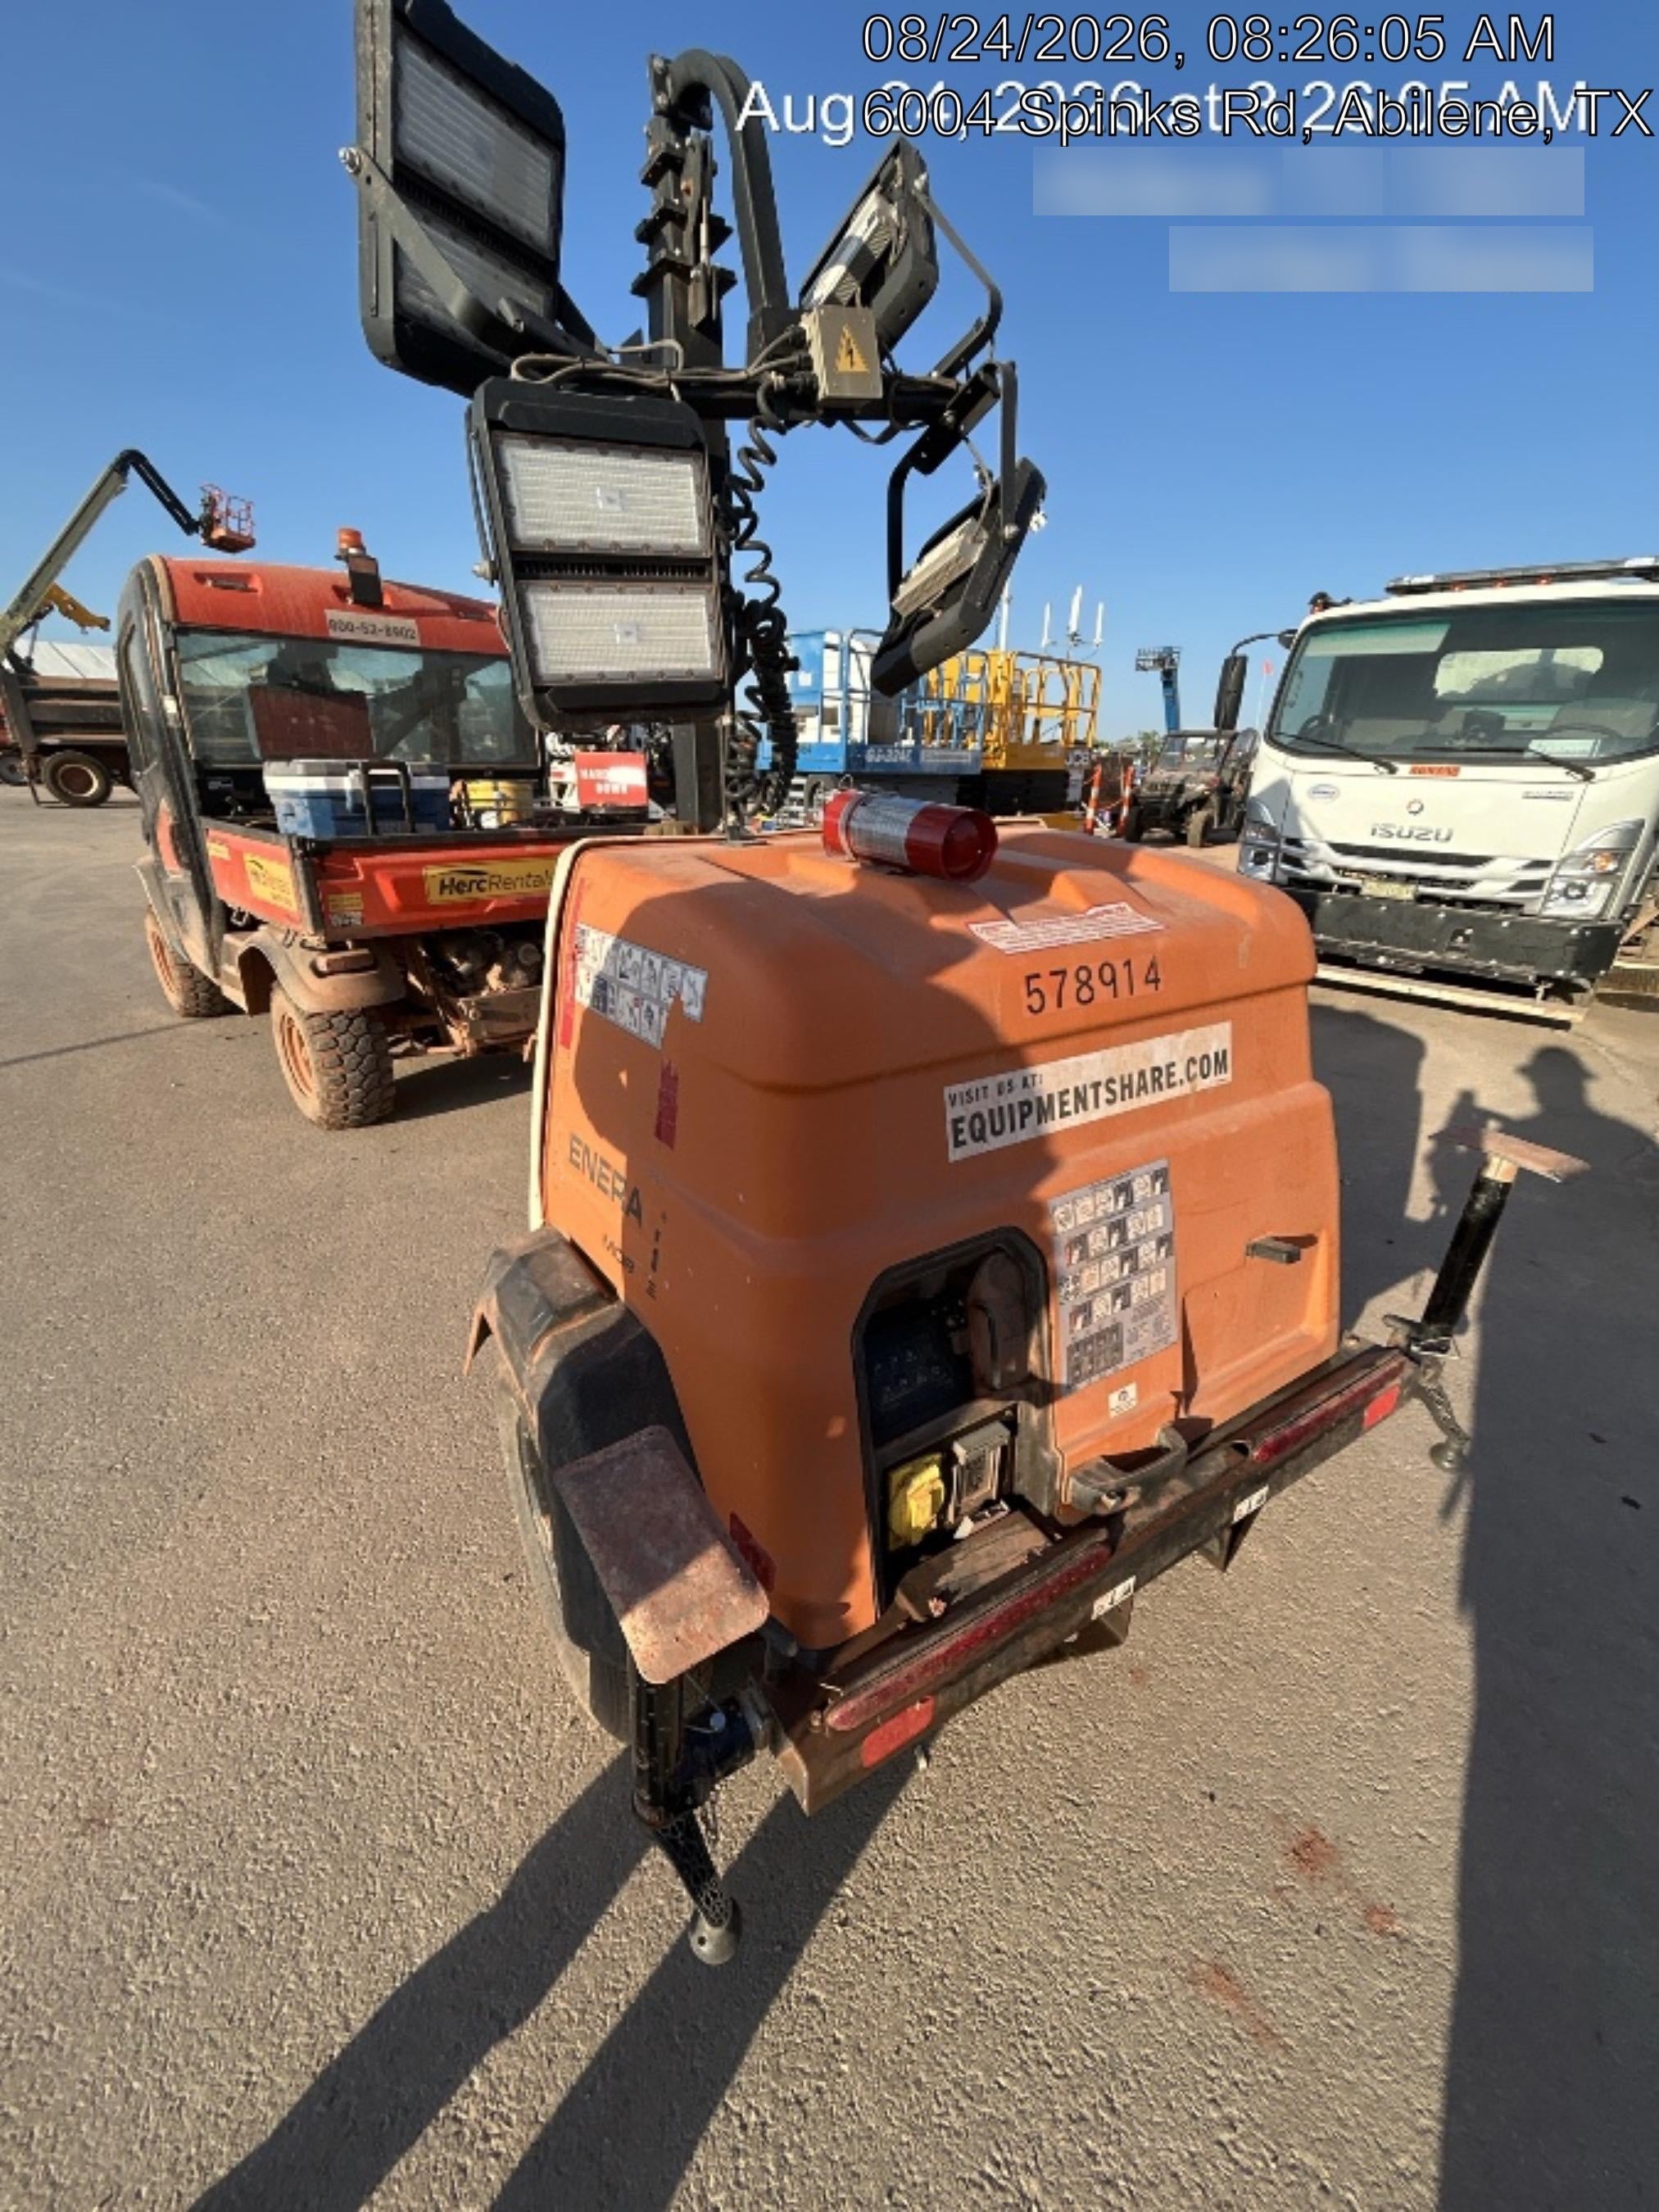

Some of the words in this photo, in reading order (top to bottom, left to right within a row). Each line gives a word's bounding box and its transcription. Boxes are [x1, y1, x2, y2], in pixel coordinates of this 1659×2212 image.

[1371, 823, 1454, 843] ISUZU
[1025, 954, 1162, 1015] 578914
[948, 1086, 989, 1108] VISIT
[997, 1079, 1013, 1097] US
[950, 1048, 1229, 1149] EQUIPMENTSHARE.COM
